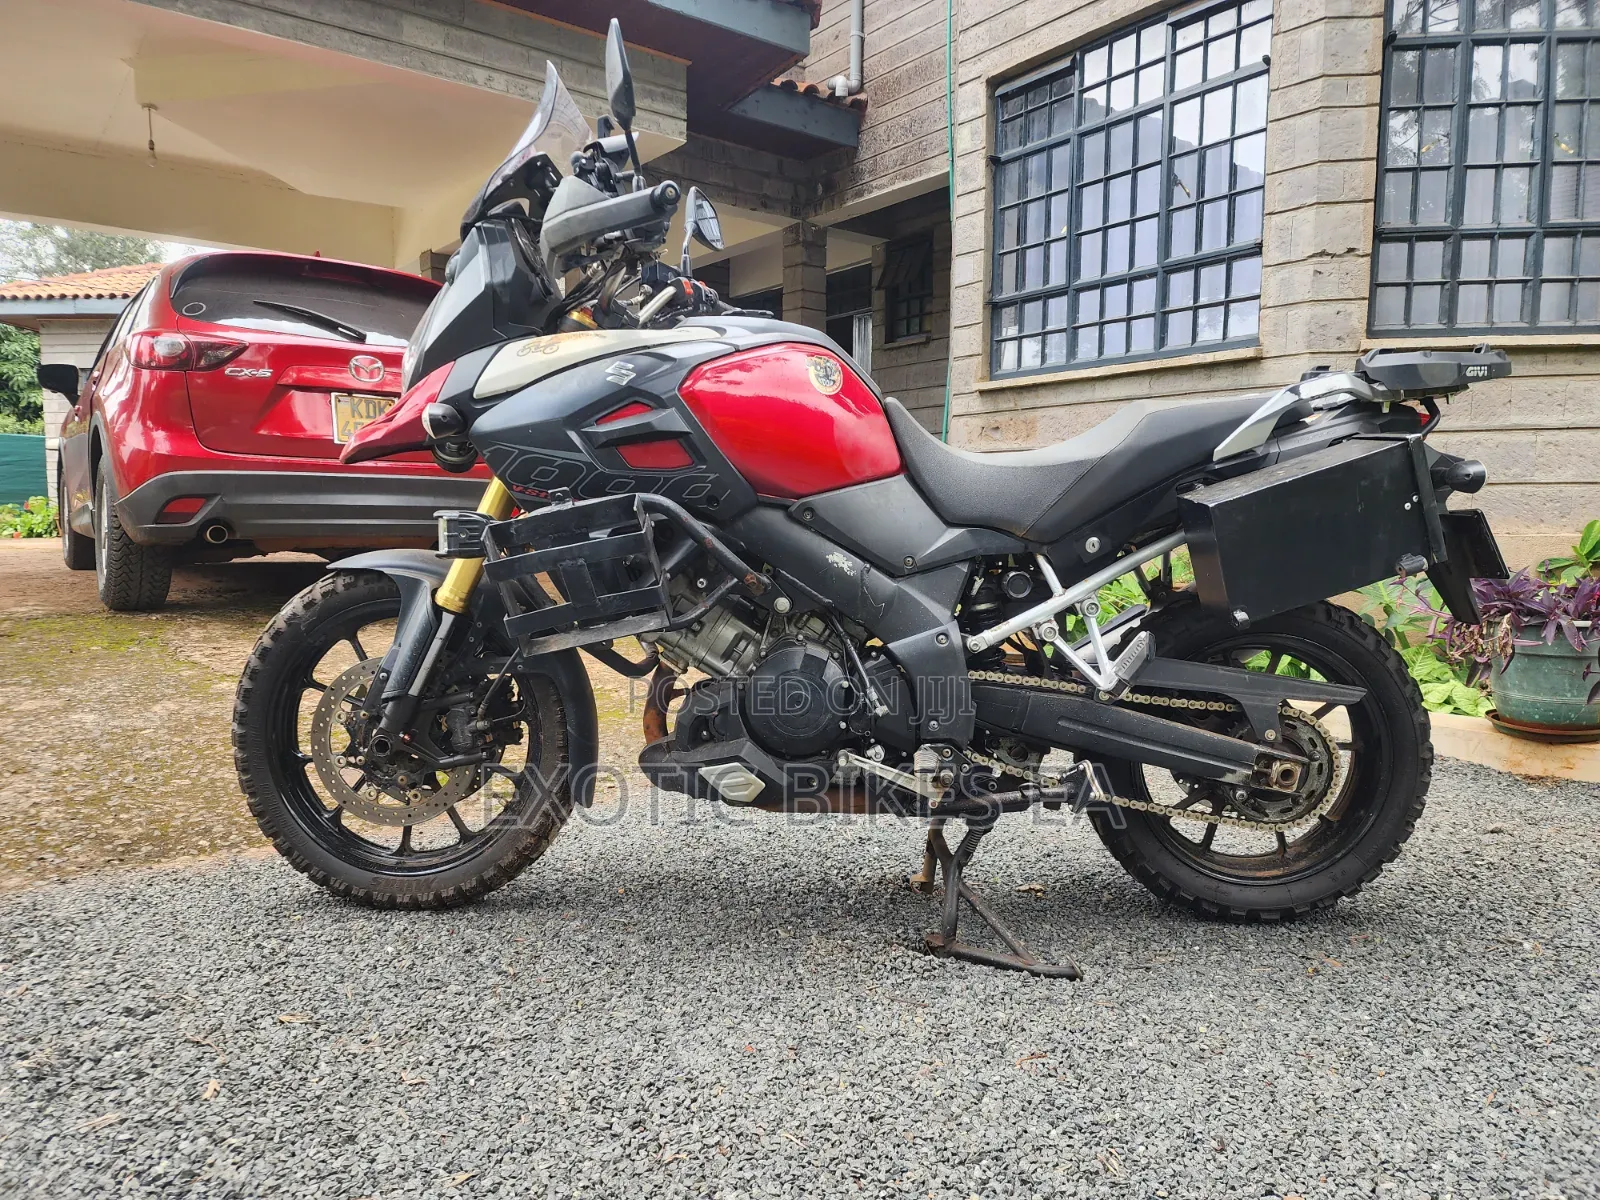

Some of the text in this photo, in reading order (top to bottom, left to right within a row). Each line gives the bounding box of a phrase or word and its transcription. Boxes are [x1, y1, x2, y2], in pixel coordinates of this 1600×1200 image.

[224, 367, 273, 378] CX-5
[1466, 366, 1488, 377] GIVI
[350, 398, 389, 419] KDK
